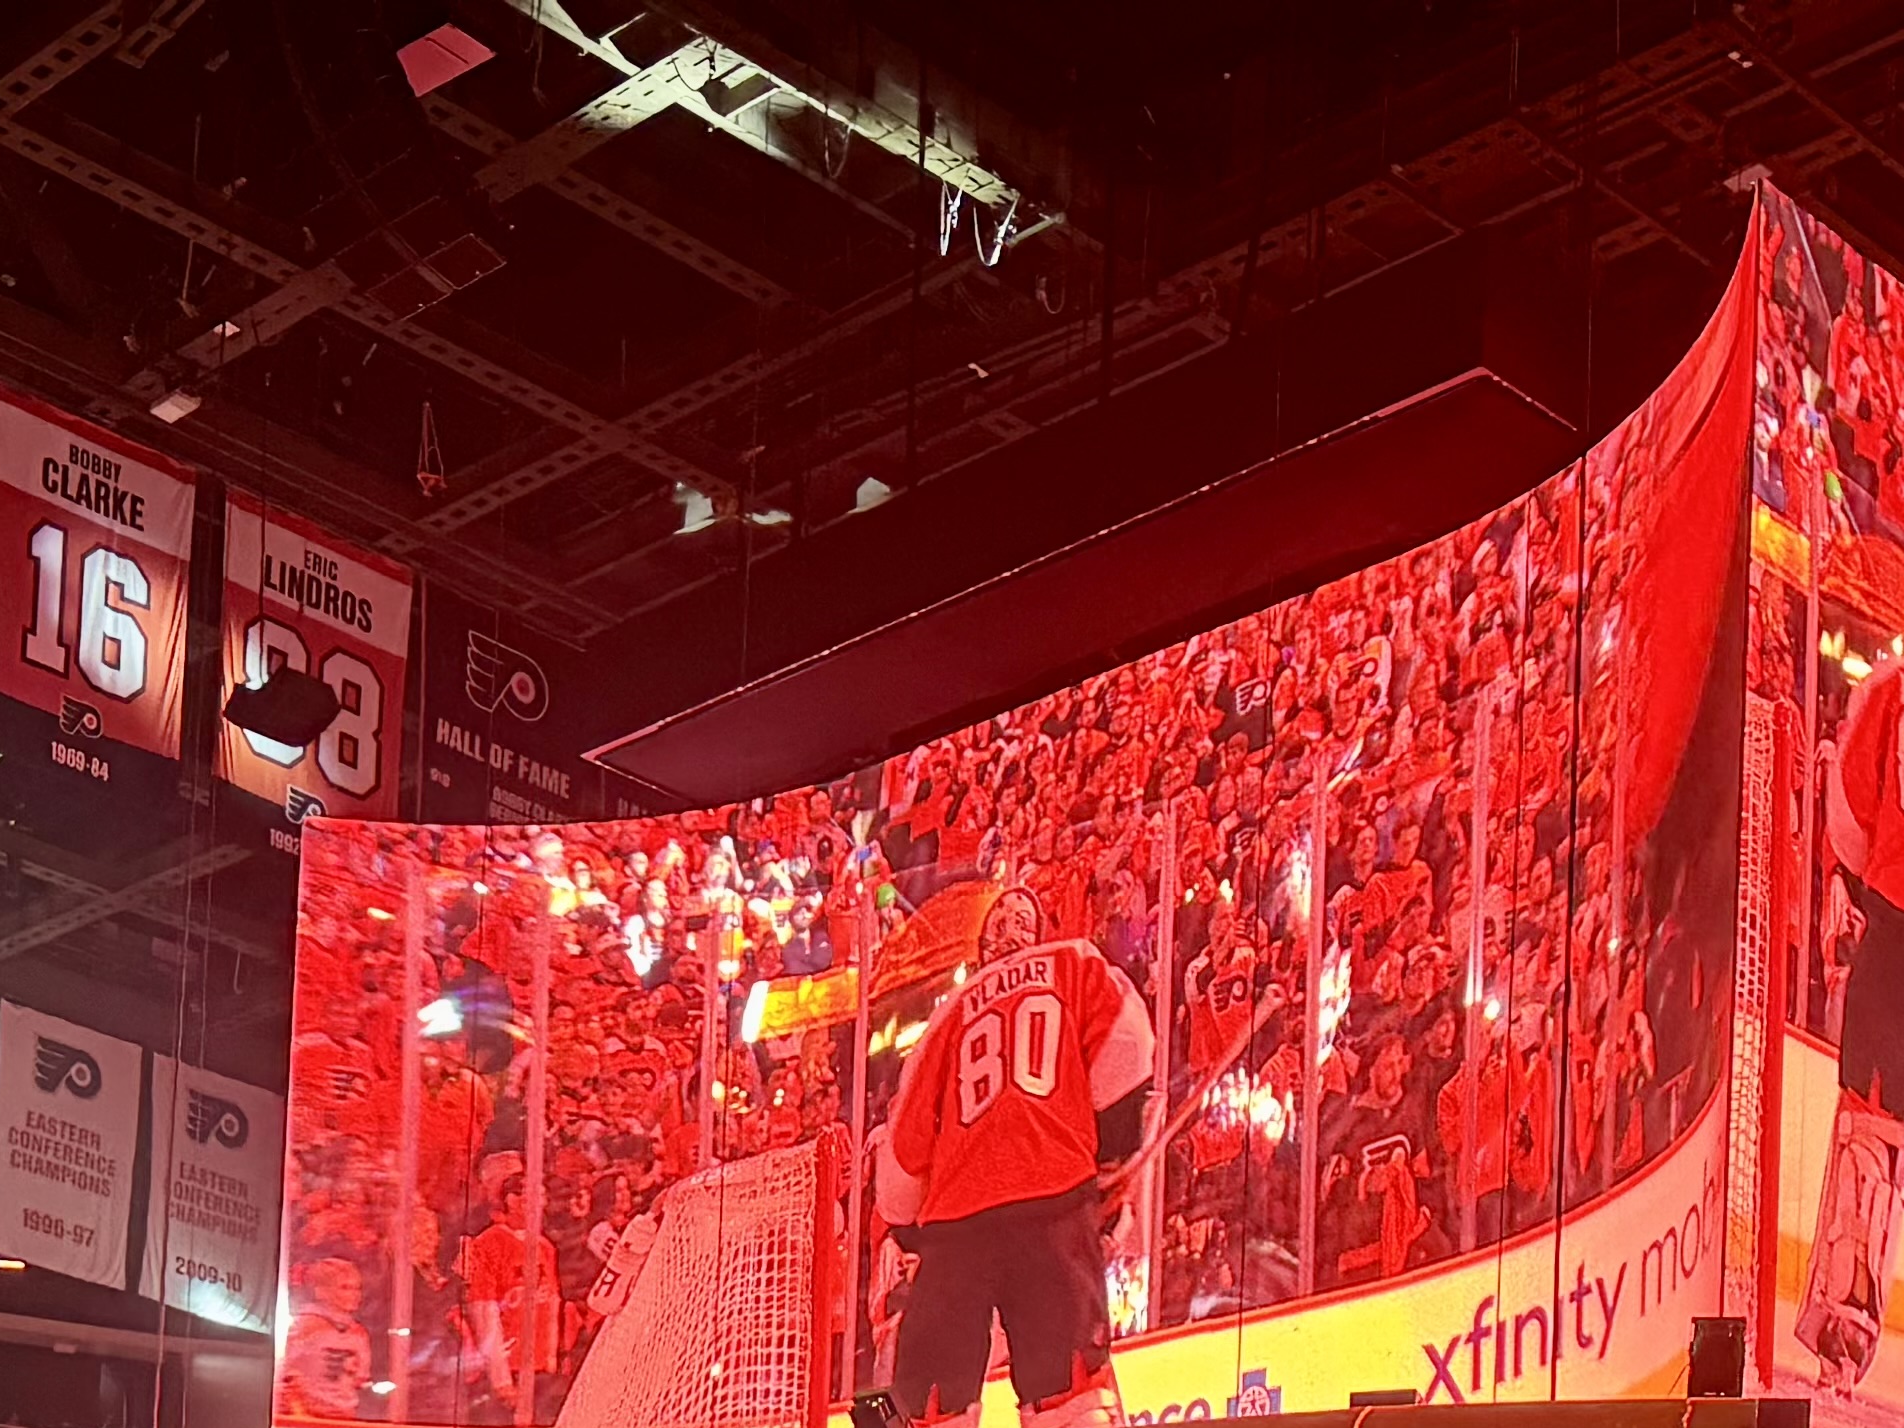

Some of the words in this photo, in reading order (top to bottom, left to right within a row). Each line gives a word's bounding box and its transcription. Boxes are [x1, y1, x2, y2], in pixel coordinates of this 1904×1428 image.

[69, 443, 123, 482] BOBBY
[41, 455, 146, 533] CLARKE
[304, 548, 338, 582] ERIC
[22, 518, 151, 703] 16
[263, 555, 373, 634] LINDROS
[51, 740, 109, 783] 1969-84
[436, 718, 484, 762] HALL
[489, 743, 514, 773] OF
[518, 755, 571, 799] FAME
[957, 990, 1063, 1129] 80
[8, 1126, 117, 1180] CONFERENCE
[25, 1109, 101, 1153] EASTERN
[9, 1148, 112, 1198] CHAMPIONS
[180, 1161, 250, 1198] EASTERN
[172, 1181, 262, 1224] ONFERENCE
[175, 1256, 242, 1293] 2009-10
